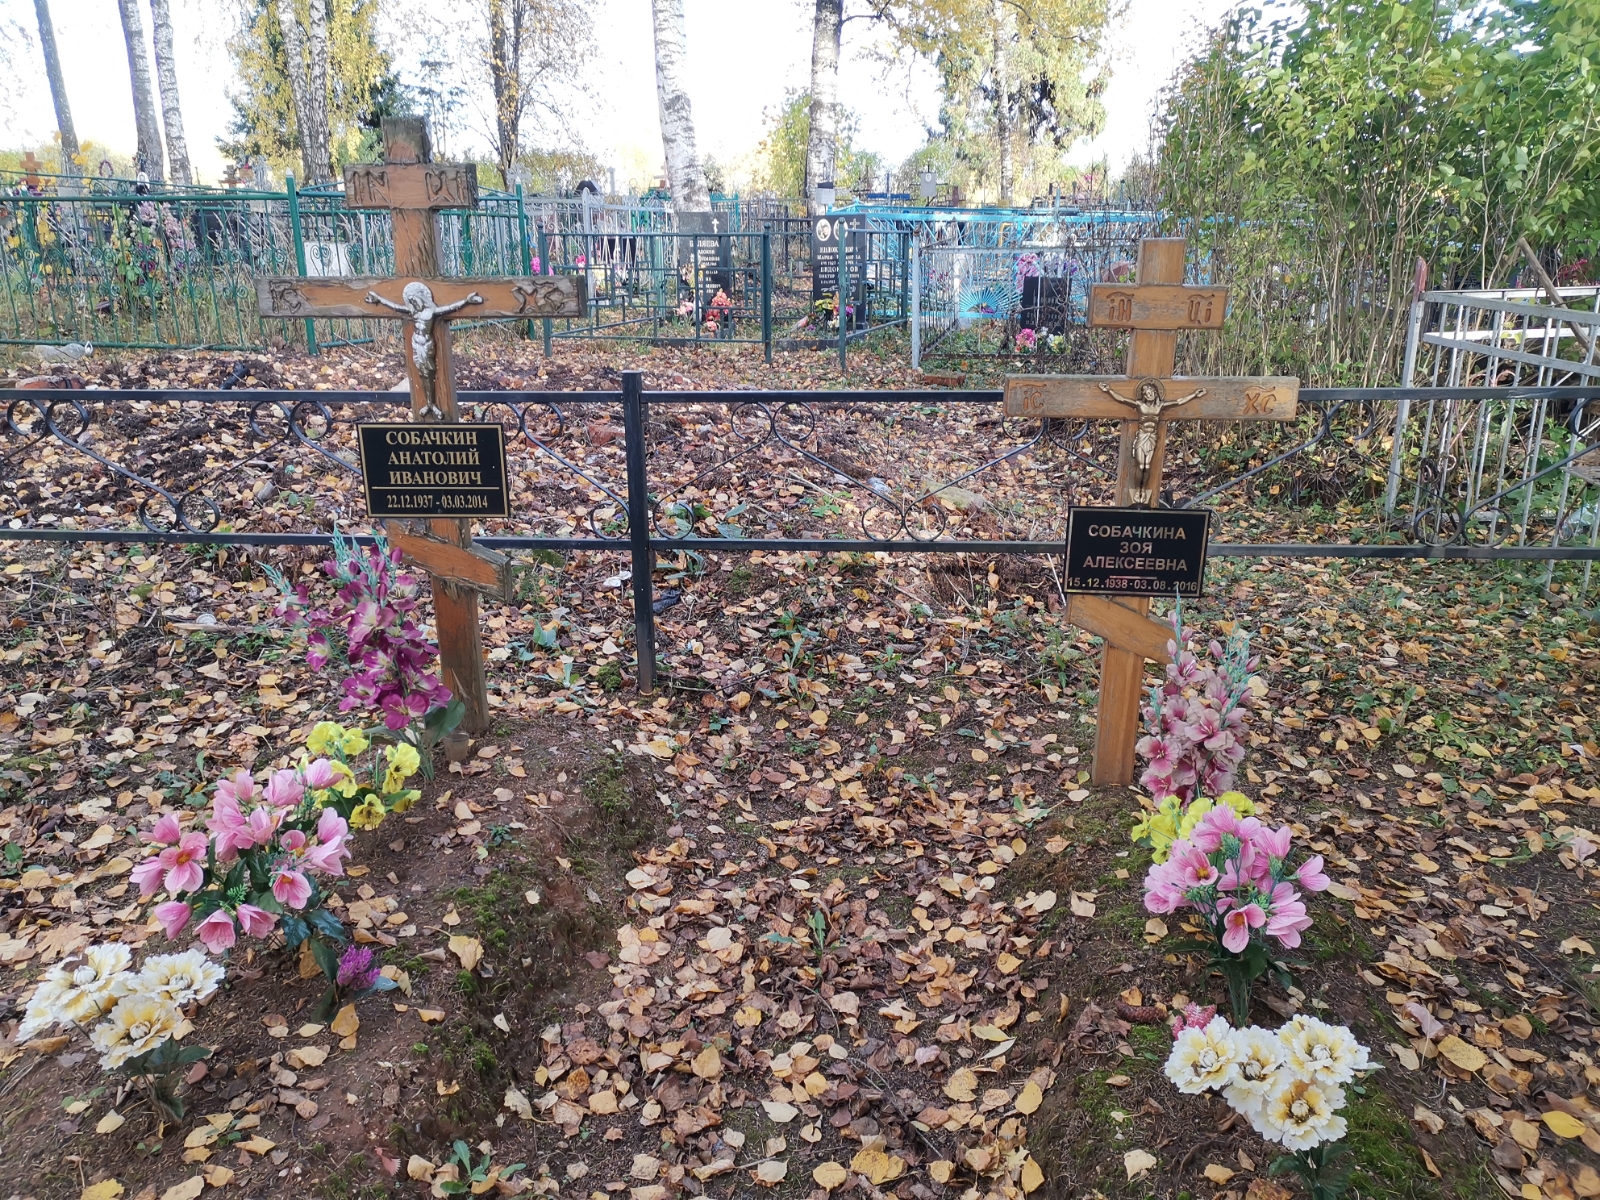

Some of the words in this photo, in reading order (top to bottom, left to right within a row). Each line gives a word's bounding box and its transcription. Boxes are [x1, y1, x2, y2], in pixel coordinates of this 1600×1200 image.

[690, 240, 719, 248] БЛЯЕВА
[385, 431, 477, 445] СОБАЧКИН
[387, 447, 480, 465] АНАТОЛИЙ
[388, 471, 482, 485] ИВАНОВИЧ
[386, 495, 433, 508] 22.12.1937
[441, 494, 488, 508] 03.03.2014
[1088, 524, 1186, 540] СОБАЧКИНА
[1119, 541, 1153, 554] ЗОЯ
[1082, 555, 1188, 572] АЛЕКСЕЕВНА
